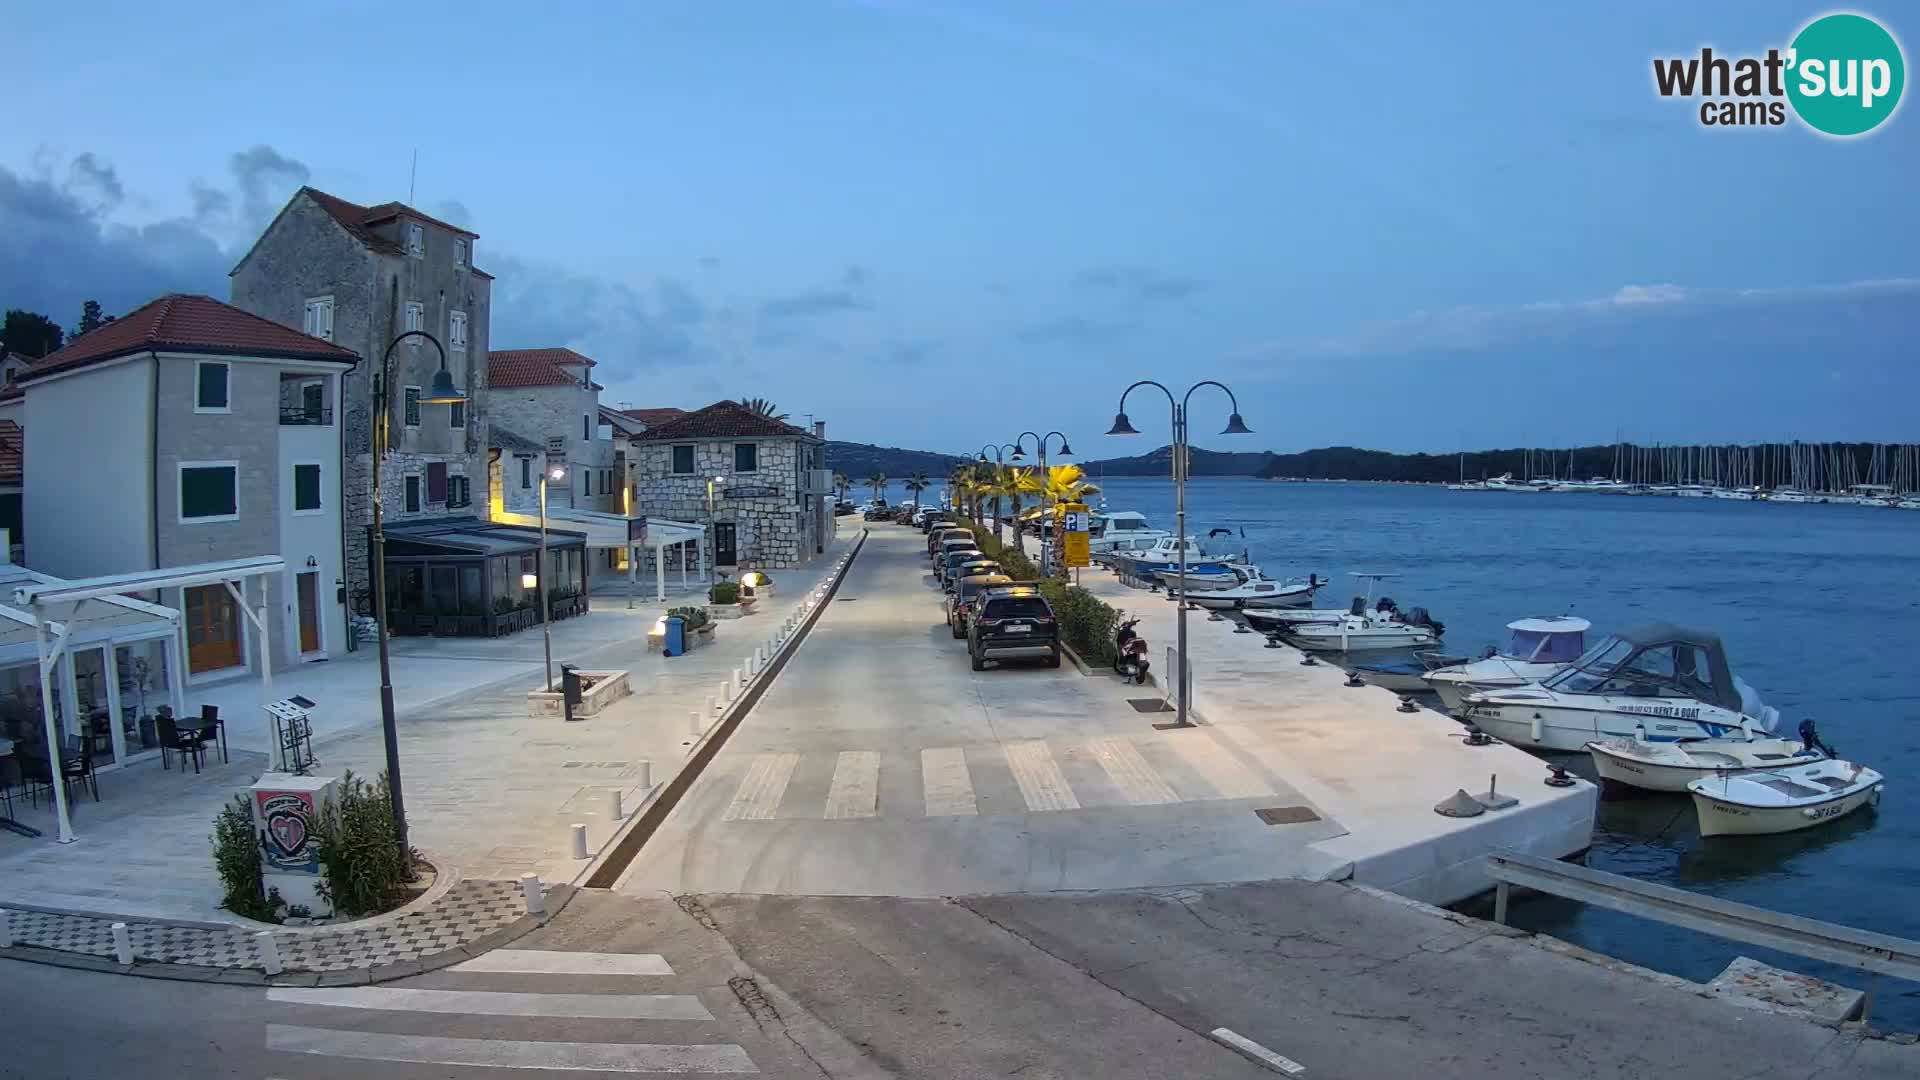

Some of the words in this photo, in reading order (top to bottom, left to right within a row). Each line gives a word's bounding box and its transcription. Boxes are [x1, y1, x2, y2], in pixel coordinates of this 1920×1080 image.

[1066, 514, 1077, 530] P
[1653, 705, 1674, 717] RENT
[1674, 707, 1680, 716] A
[1681, 707, 1700, 720] BOAT
